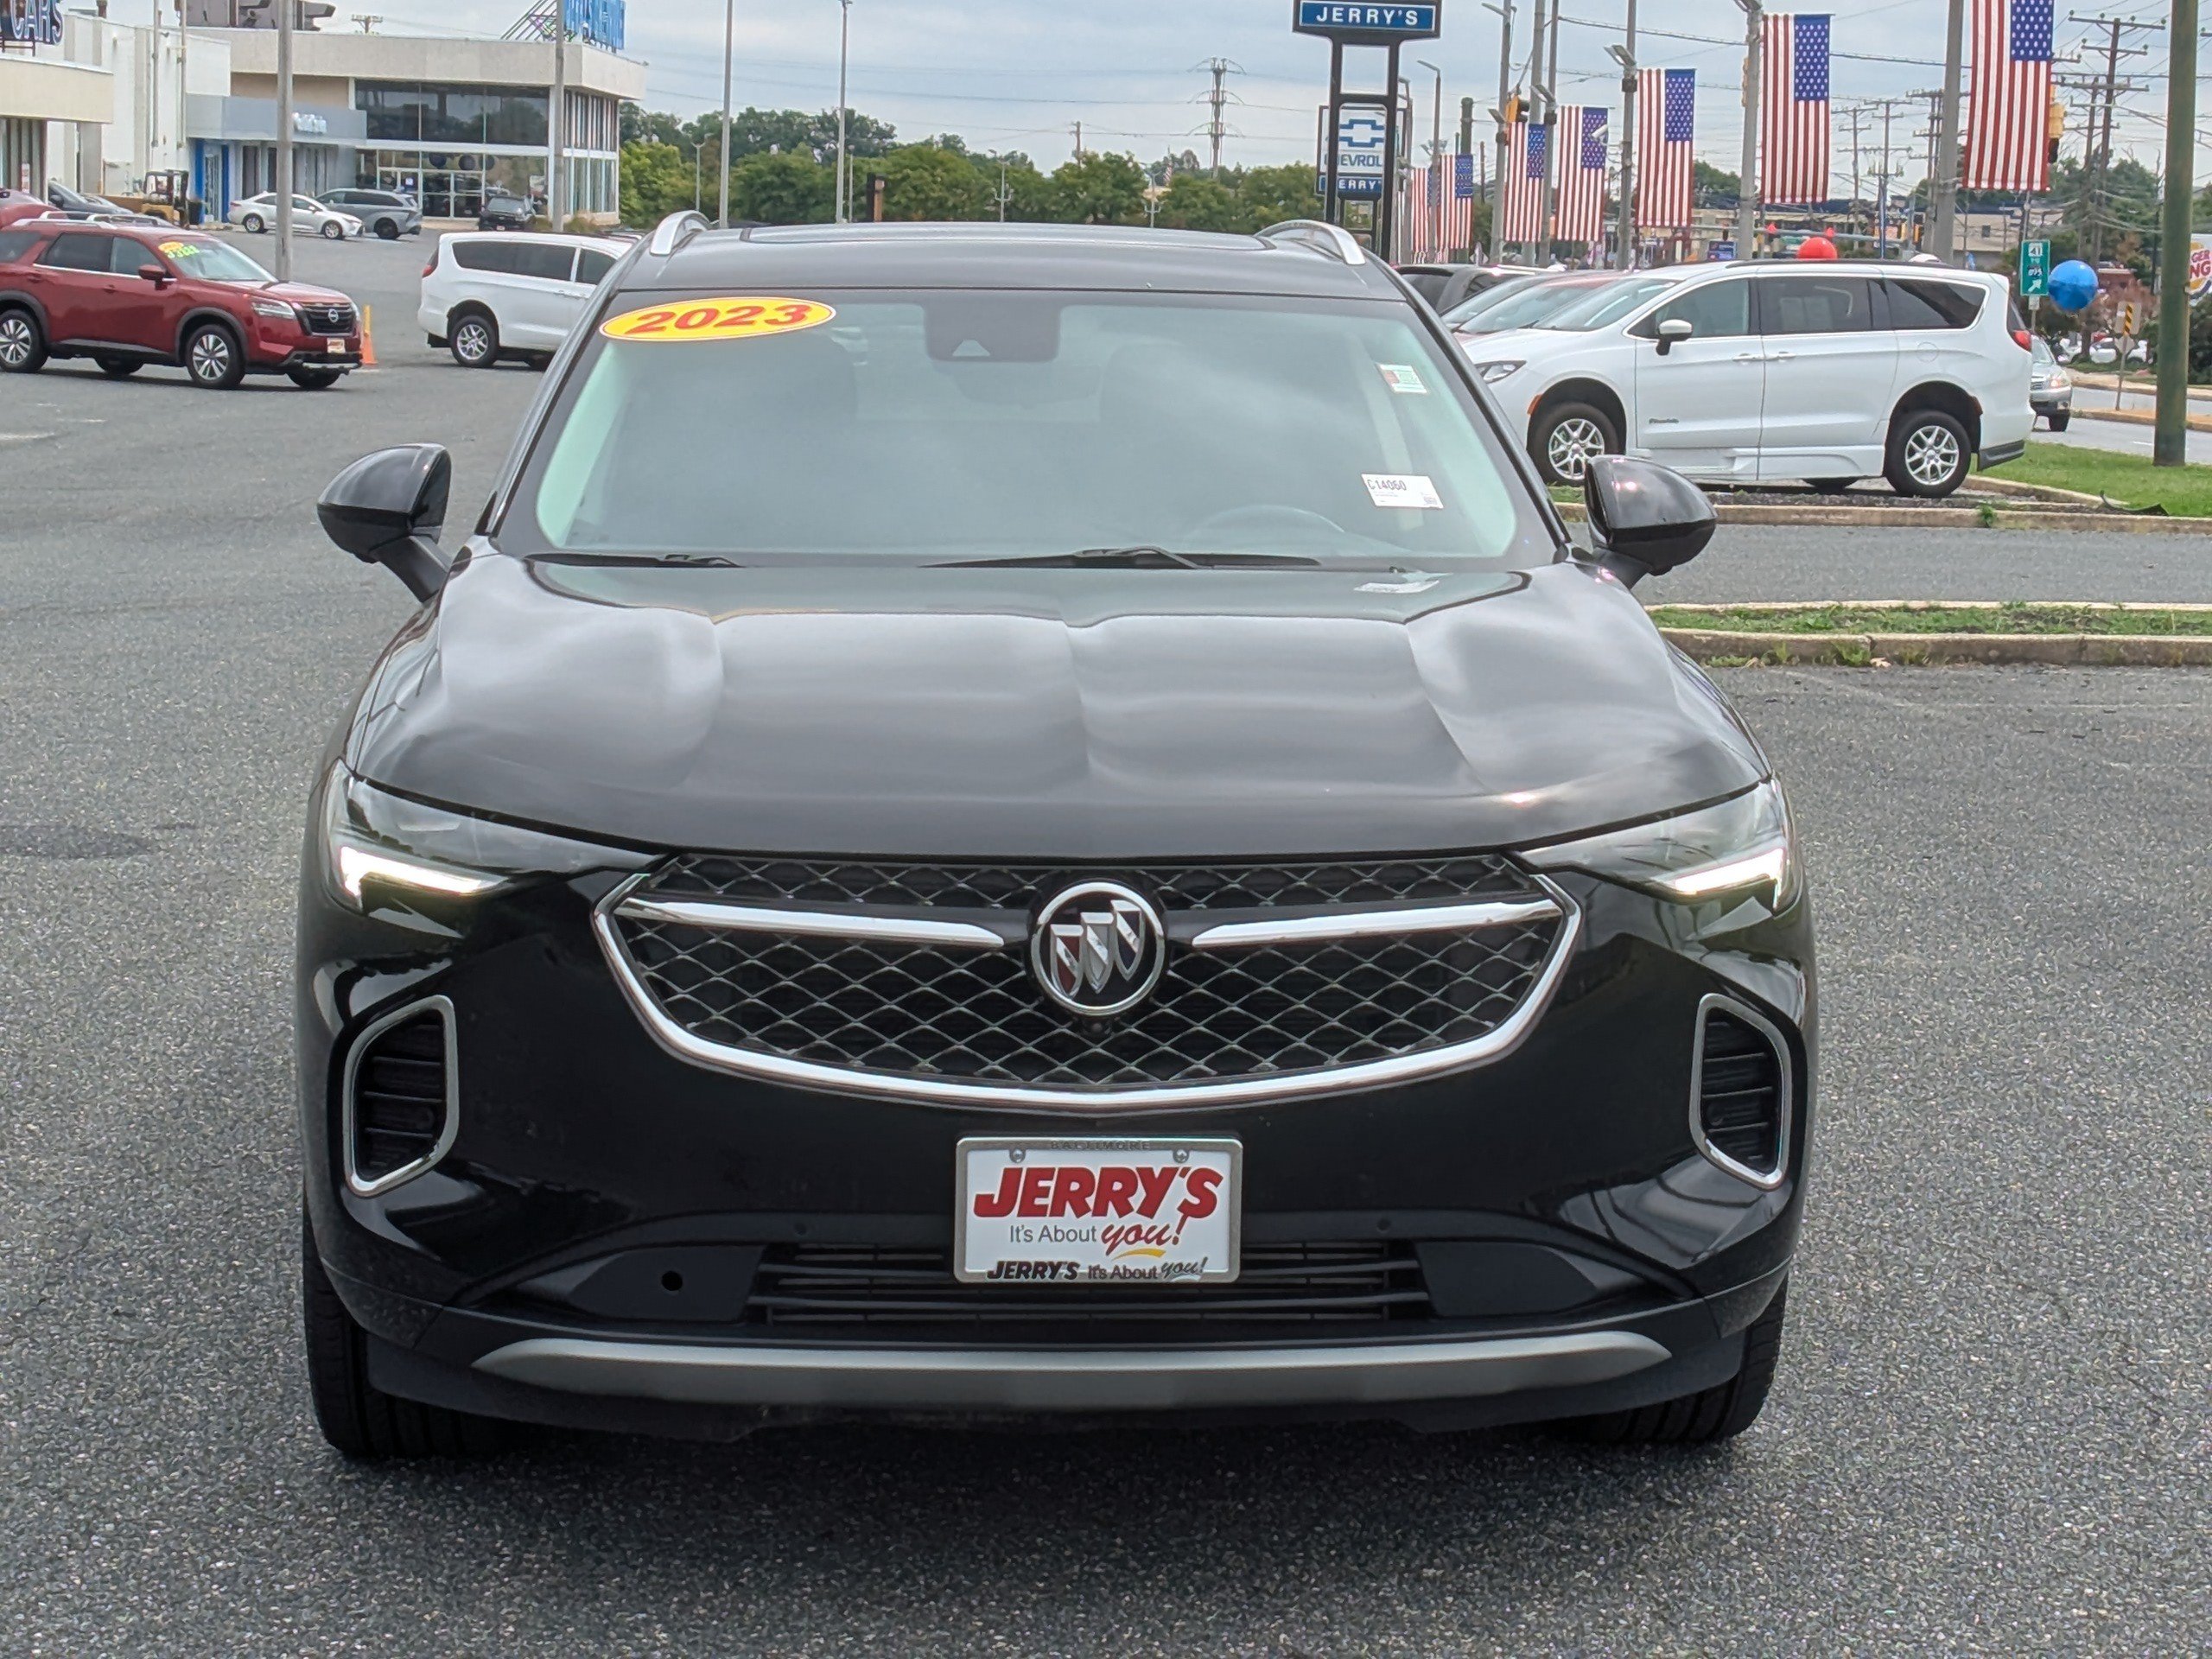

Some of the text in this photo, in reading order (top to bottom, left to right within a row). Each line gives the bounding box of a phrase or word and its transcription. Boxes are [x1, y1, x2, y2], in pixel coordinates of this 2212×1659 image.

[1315, 6, 1419, 26] JERRY'S
[2191, 249, 2210, 263] GER
[2190, 260, 2211, 278] NG
[624, 304, 810, 334] 2023
[1051, 1141, 1151, 1150] BALTIMORE
[974, 1166, 1224, 1219] JERRY'S
[1010, 1214, 1187, 1256] It's About you!
[987, 1256, 1208, 1280] JERRY'S It's About you!
